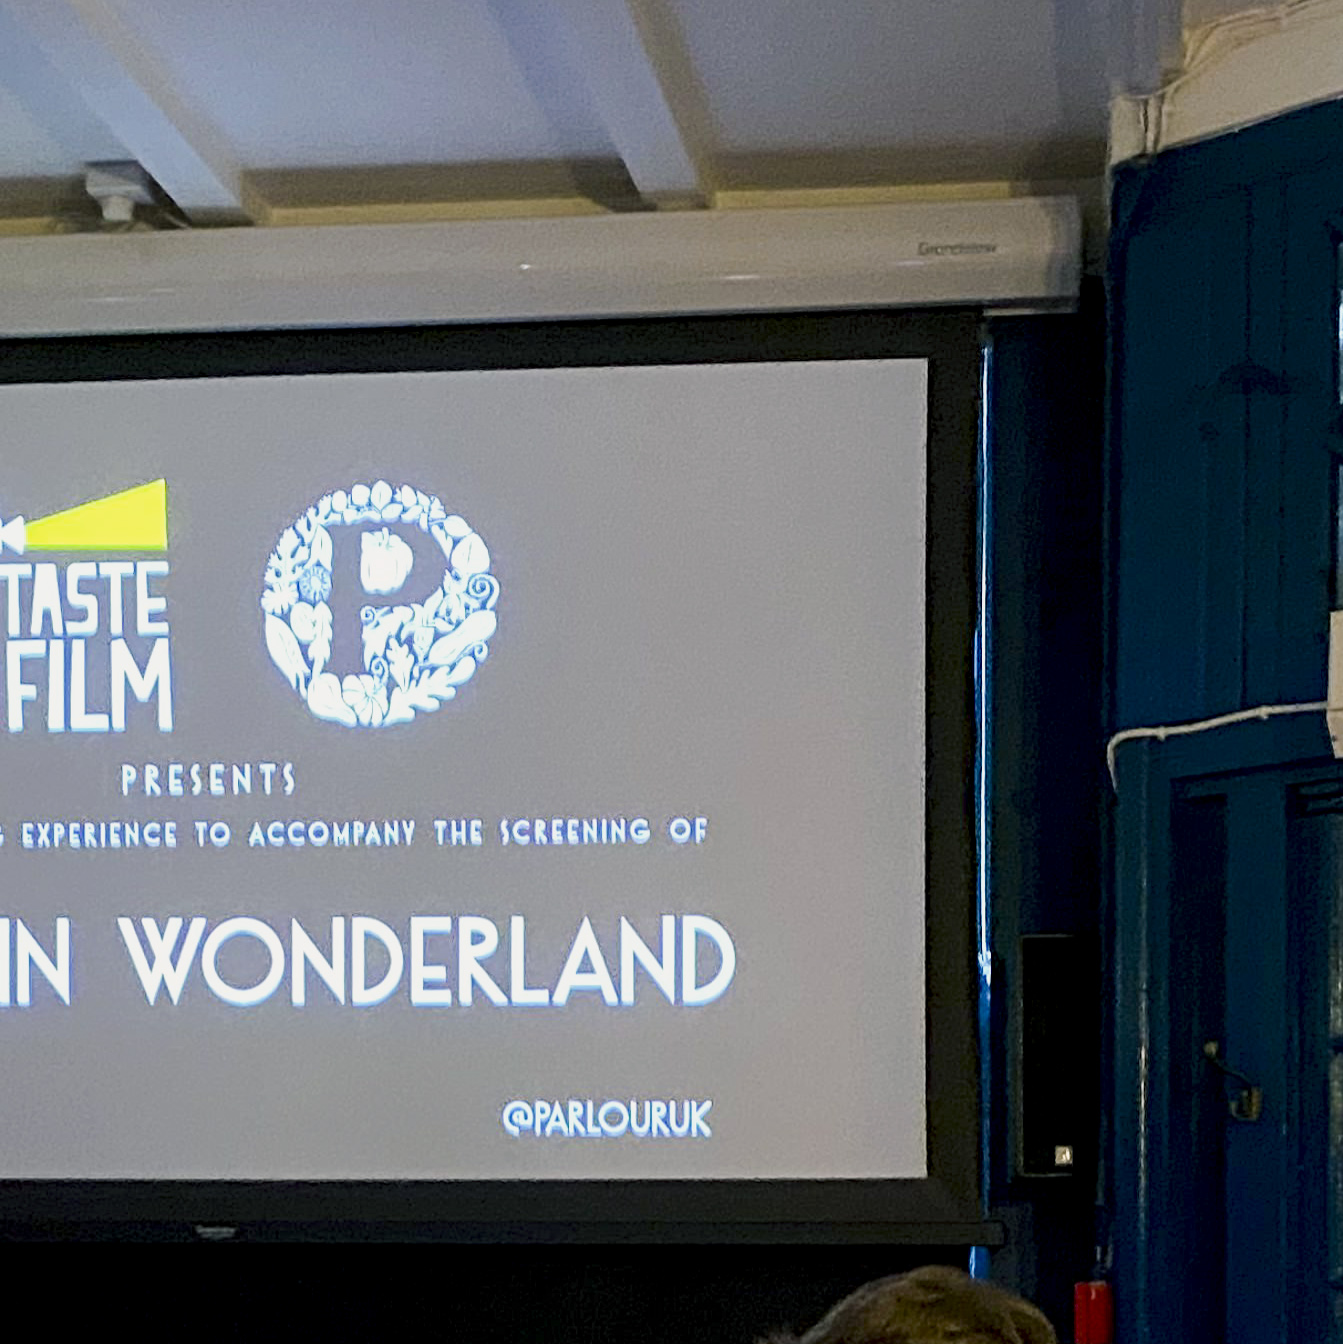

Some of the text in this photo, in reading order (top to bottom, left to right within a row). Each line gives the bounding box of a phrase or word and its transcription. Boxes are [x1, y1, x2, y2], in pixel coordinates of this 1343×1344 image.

[6, 636, 174, 734] FILM
[120, 760, 297, 797] PRESENTS
[20, 820, 178, 849] EXPERIENCE
[193, 820, 233, 848] TO
[247, 819, 417, 848] ACCOMPANY
[433, 818, 484, 846] THE
[498, 817, 652, 846] SCREENING
[668, 816, 709, 844] OF
[116, 914, 737, 1009] WONDERLAND
[501, 1099, 714, 1138] @PARLOURUK
